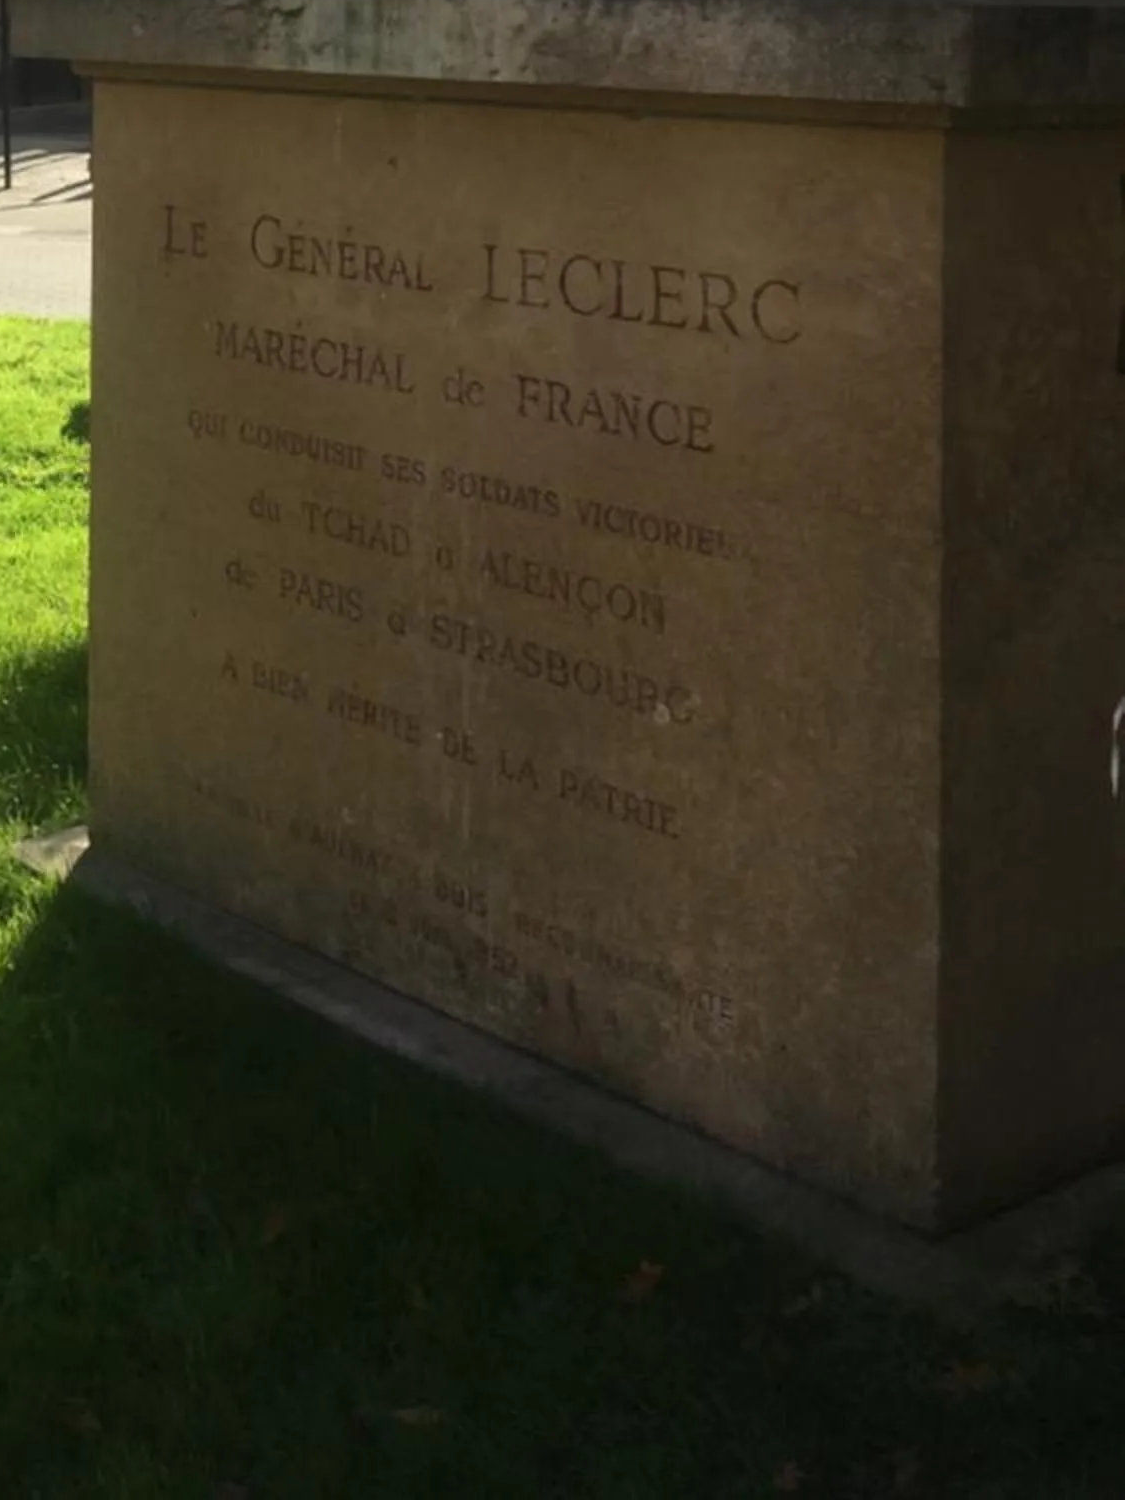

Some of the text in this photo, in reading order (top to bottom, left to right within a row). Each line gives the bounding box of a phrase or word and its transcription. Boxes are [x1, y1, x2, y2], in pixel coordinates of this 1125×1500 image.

[249, 212, 434, 292] GÉNÉRAL
[480, 243, 803, 344] LECLERC
[214, 318, 715, 455] MARÉCHAL de FRANCE
[187, 408, 227, 440] QUI
[237, 417, 369, 471] CONDUISIT
[380, 452, 427, 487] SES
[440, 466, 561, 519] SOLDATS
[248, 488, 283, 524] du
[301, 500, 411, 557] TCHAD
[479, 542, 666, 635] ALENÇON
[225, 557, 258, 590] de
[279, 567, 364, 623] PARIS
[428, 613, 696, 725] STRASBOURG
[221, 648, 238, 681] A
[251, 660, 309, 703] BIEN
[441, 725, 478, 767] DE
[498, 748, 540, 791] LA
[558, 767, 682, 841] PATRIE
